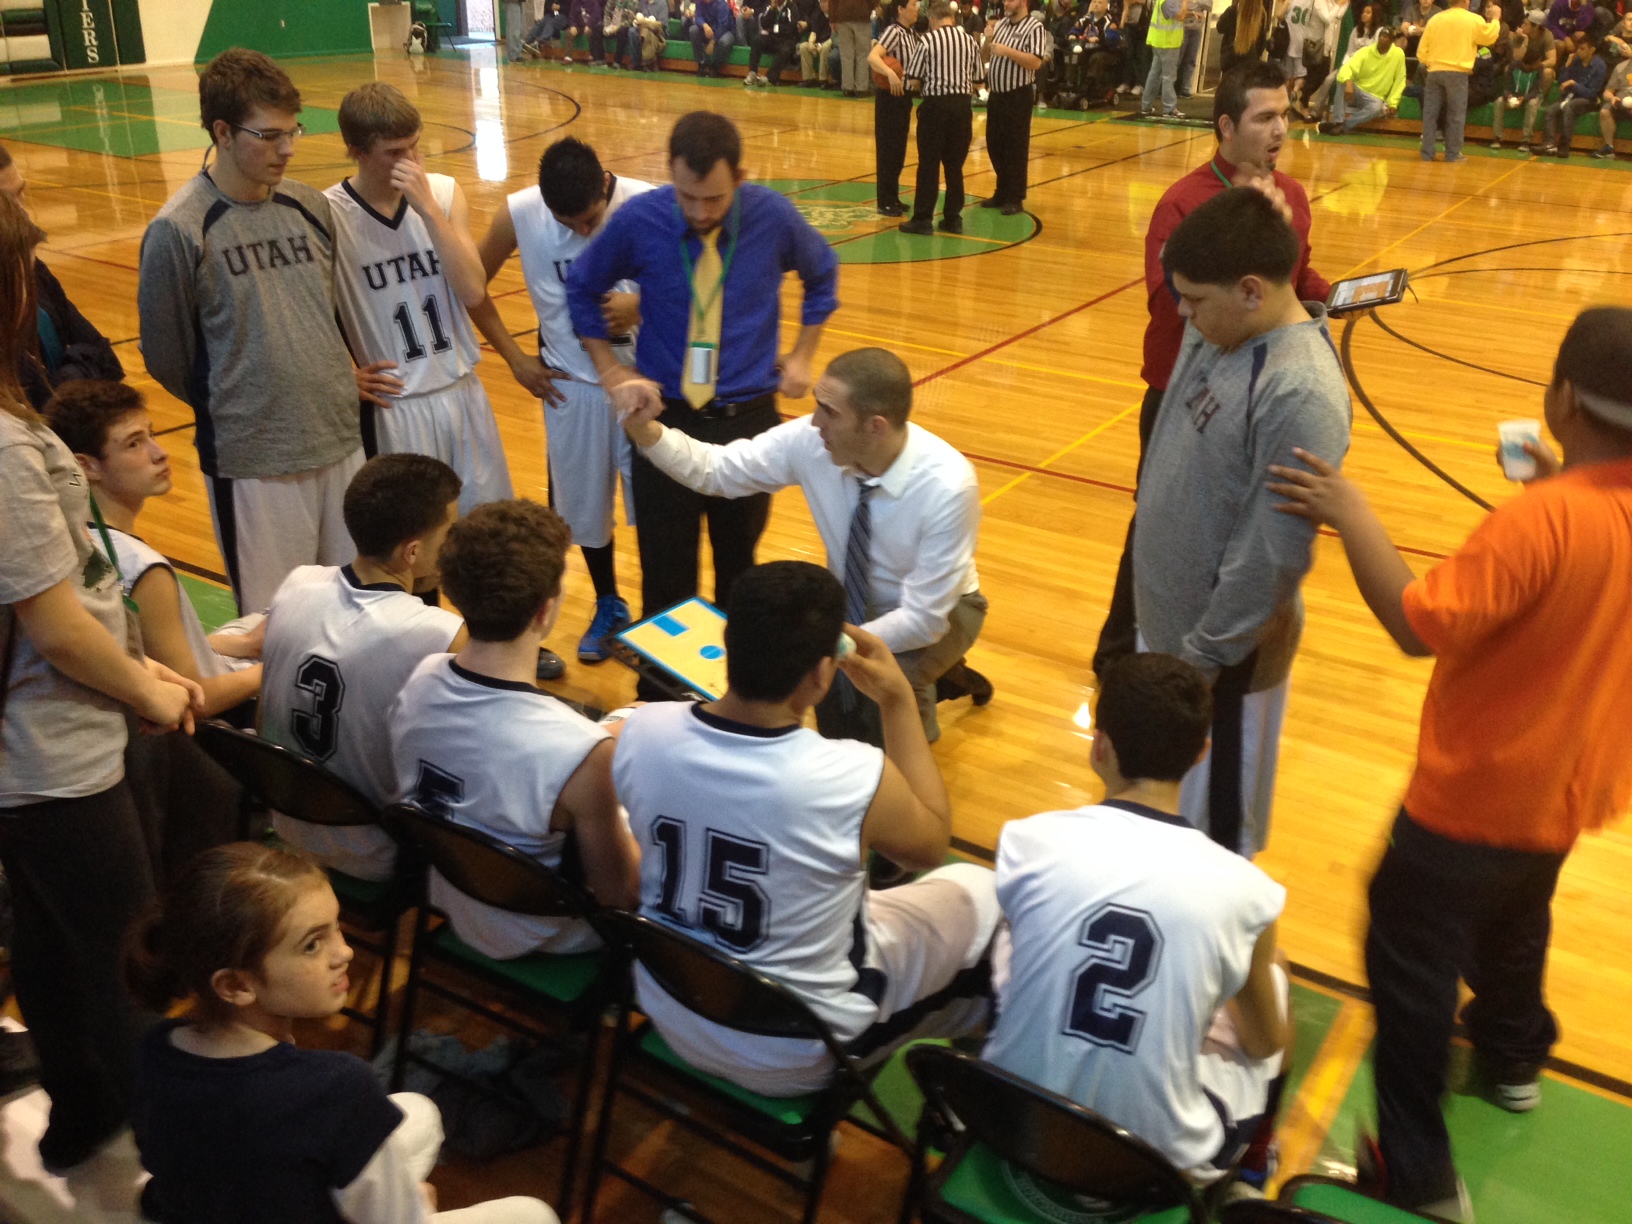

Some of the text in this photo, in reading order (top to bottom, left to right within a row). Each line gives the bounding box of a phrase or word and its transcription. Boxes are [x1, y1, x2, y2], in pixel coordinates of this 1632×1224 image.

[222, 235, 314, 276] UTAH
[393, 294, 453, 363] 11
[291, 655, 346, 763] 3
[650, 815, 772, 955] 15
[1060, 902, 1166, 1056] 2
